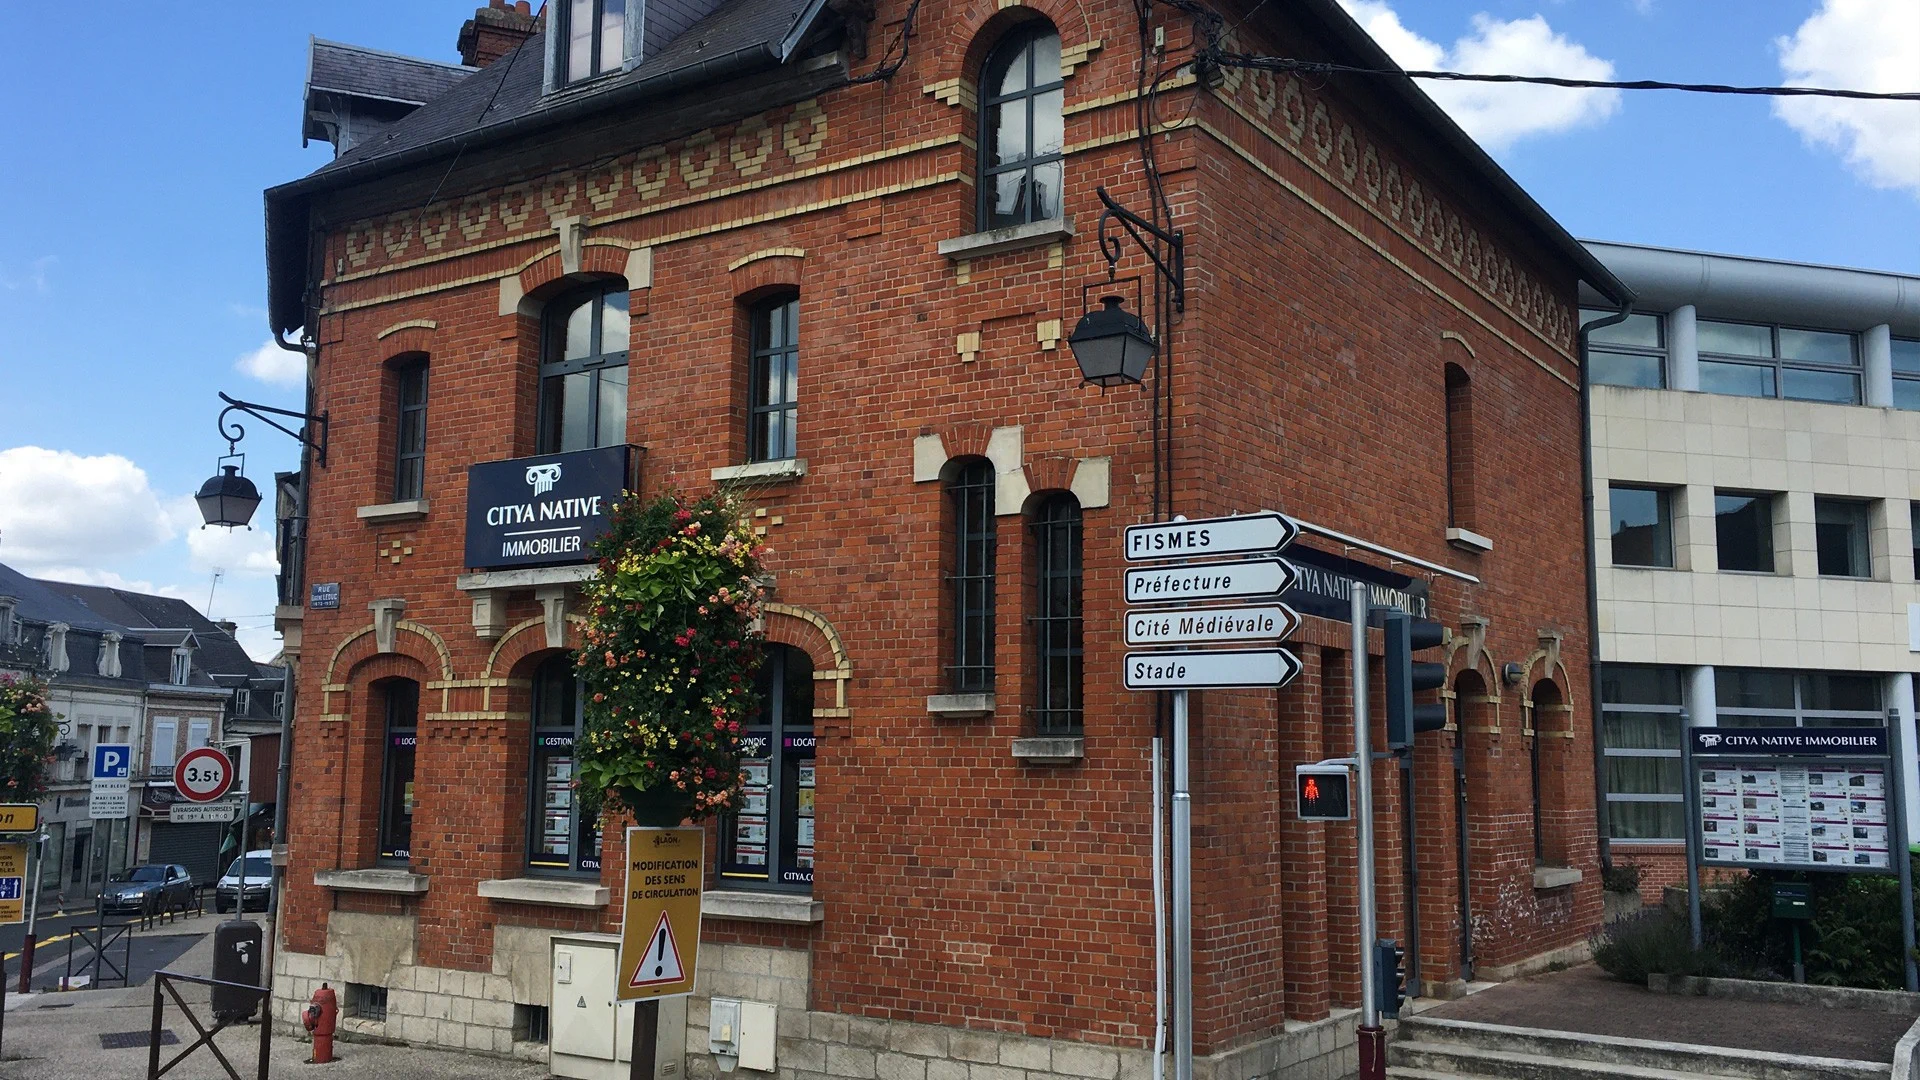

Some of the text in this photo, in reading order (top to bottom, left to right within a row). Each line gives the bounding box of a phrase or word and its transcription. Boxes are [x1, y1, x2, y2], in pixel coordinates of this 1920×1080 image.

[486, 496, 601, 526] CITYA NATIVE
[502, 535, 581, 557] IMMOBILIER
[1133, 529, 1211, 551] FISMES
[1134, 571, 1232, 594] Préfecture
[1134, 614, 1275, 637] Cité Médiévale
[1134, 661, 1187, 680] Stade
[545, 737, 573, 746] GESTION
[740, 737, 767, 746] SYNDIC
[1725, 736, 1878, 746] CITYA NATIVE IMMOBILIER
[104, 752, 120, 772] P
[632, 860, 698, 871] MODIFICATION
[645, 874, 686, 885] DES SENS
[632, 888, 698, 899] DE CIRCULATION
